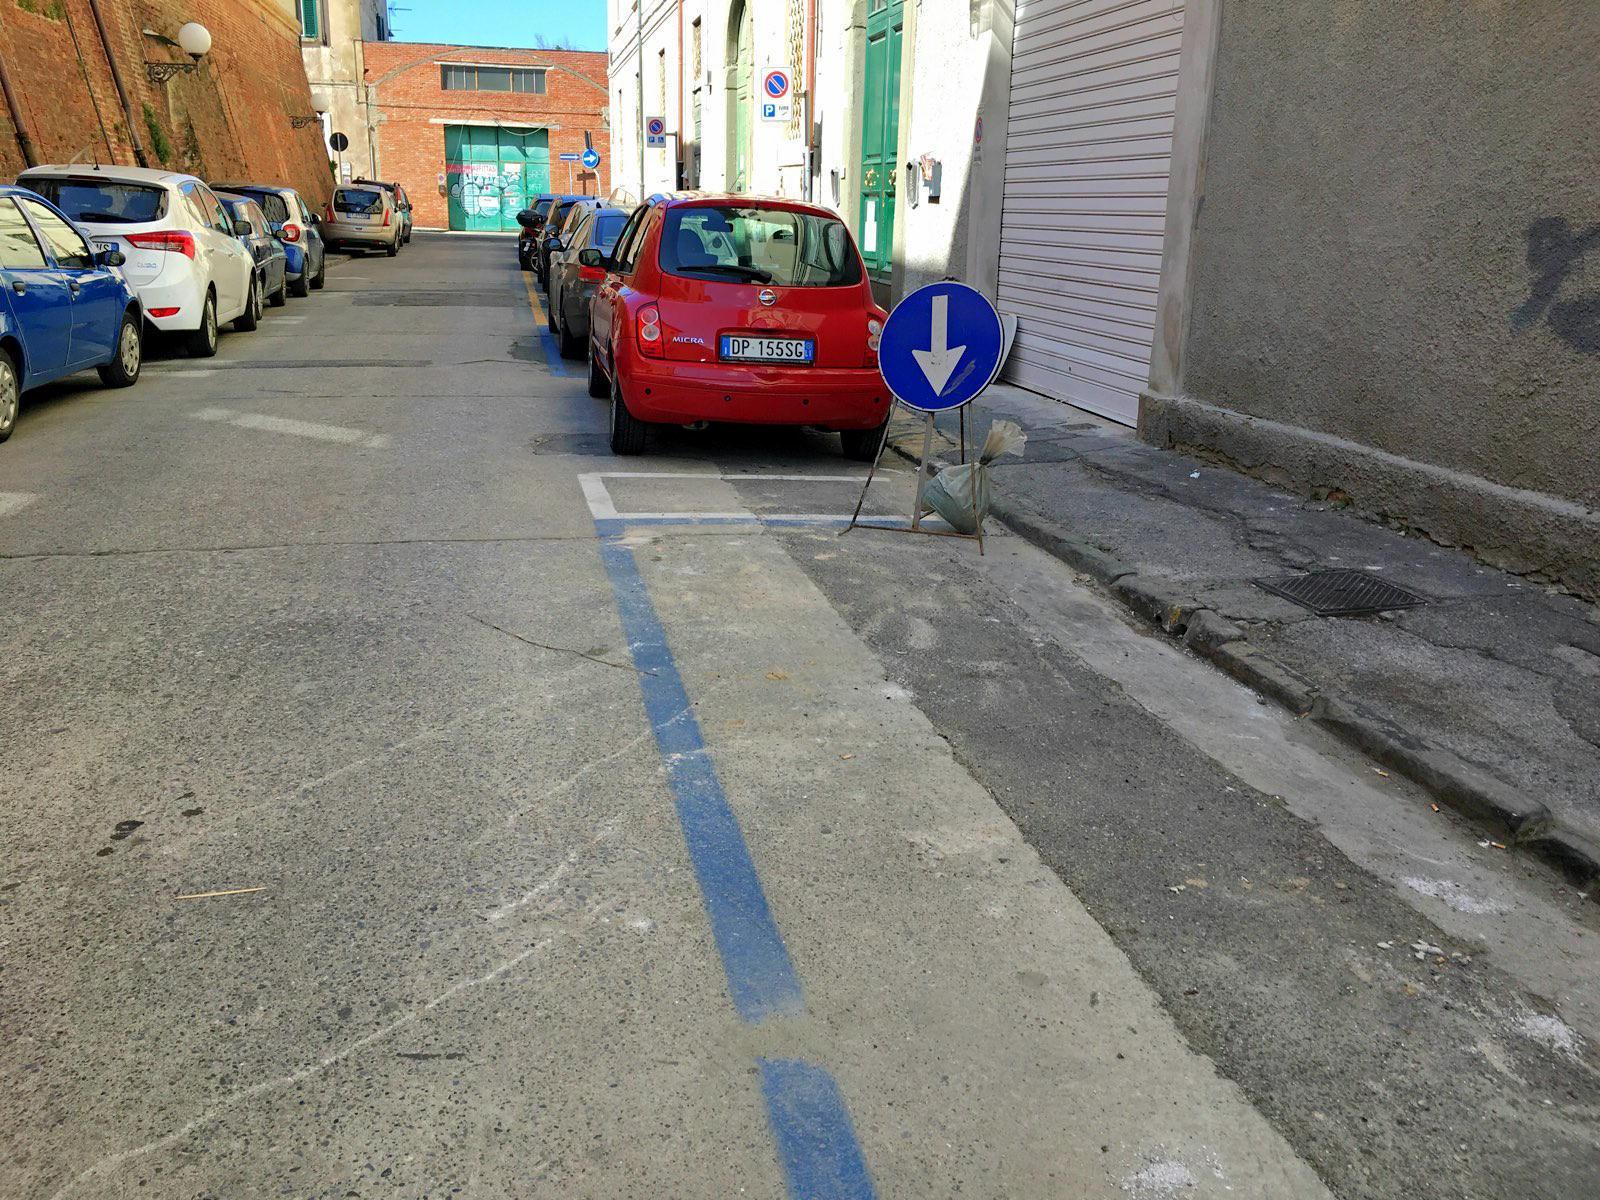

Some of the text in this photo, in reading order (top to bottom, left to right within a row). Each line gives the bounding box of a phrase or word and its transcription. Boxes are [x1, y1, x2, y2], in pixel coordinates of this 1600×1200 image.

[672, 336, 705, 345] MICRA
[732, 339, 803, 358] DP 155SG
